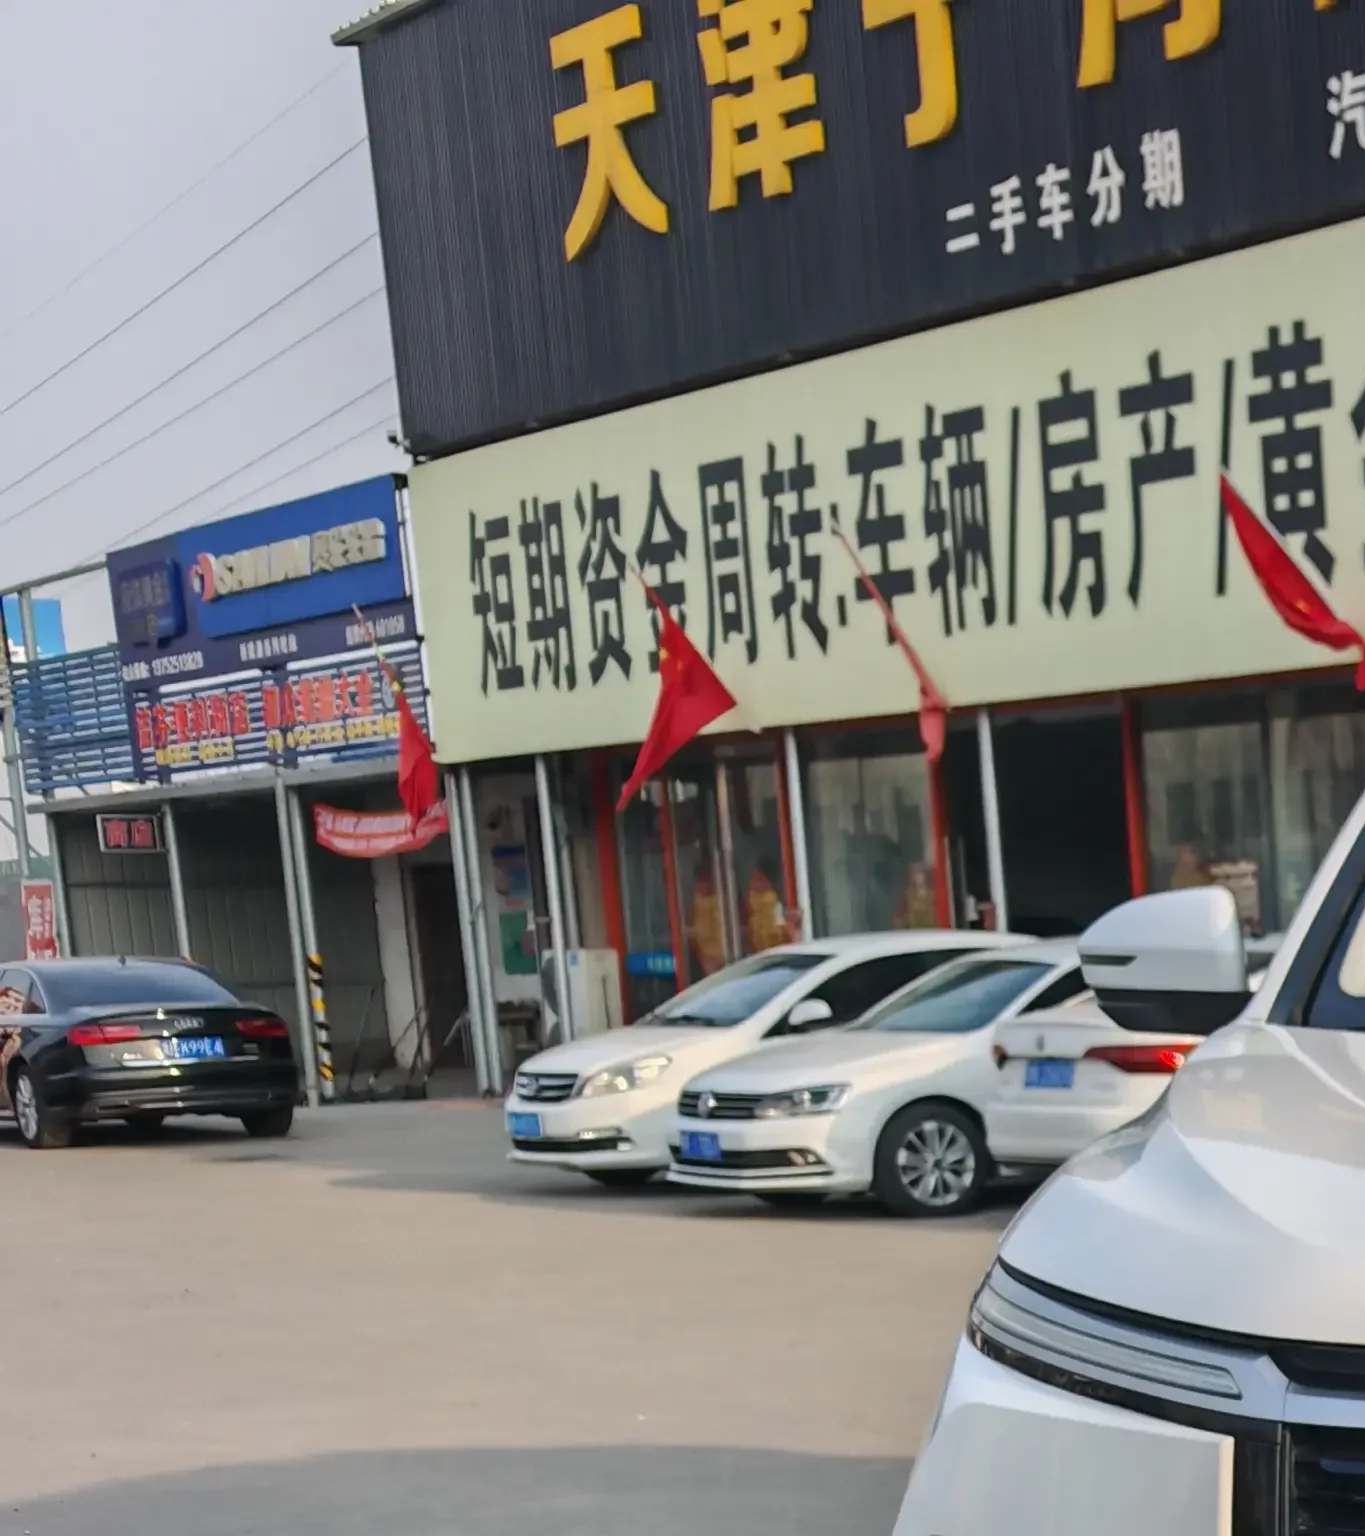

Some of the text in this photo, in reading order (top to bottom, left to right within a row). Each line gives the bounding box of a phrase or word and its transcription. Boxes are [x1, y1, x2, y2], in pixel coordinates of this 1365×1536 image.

[945, 128, 1185, 255] 二手车分期
